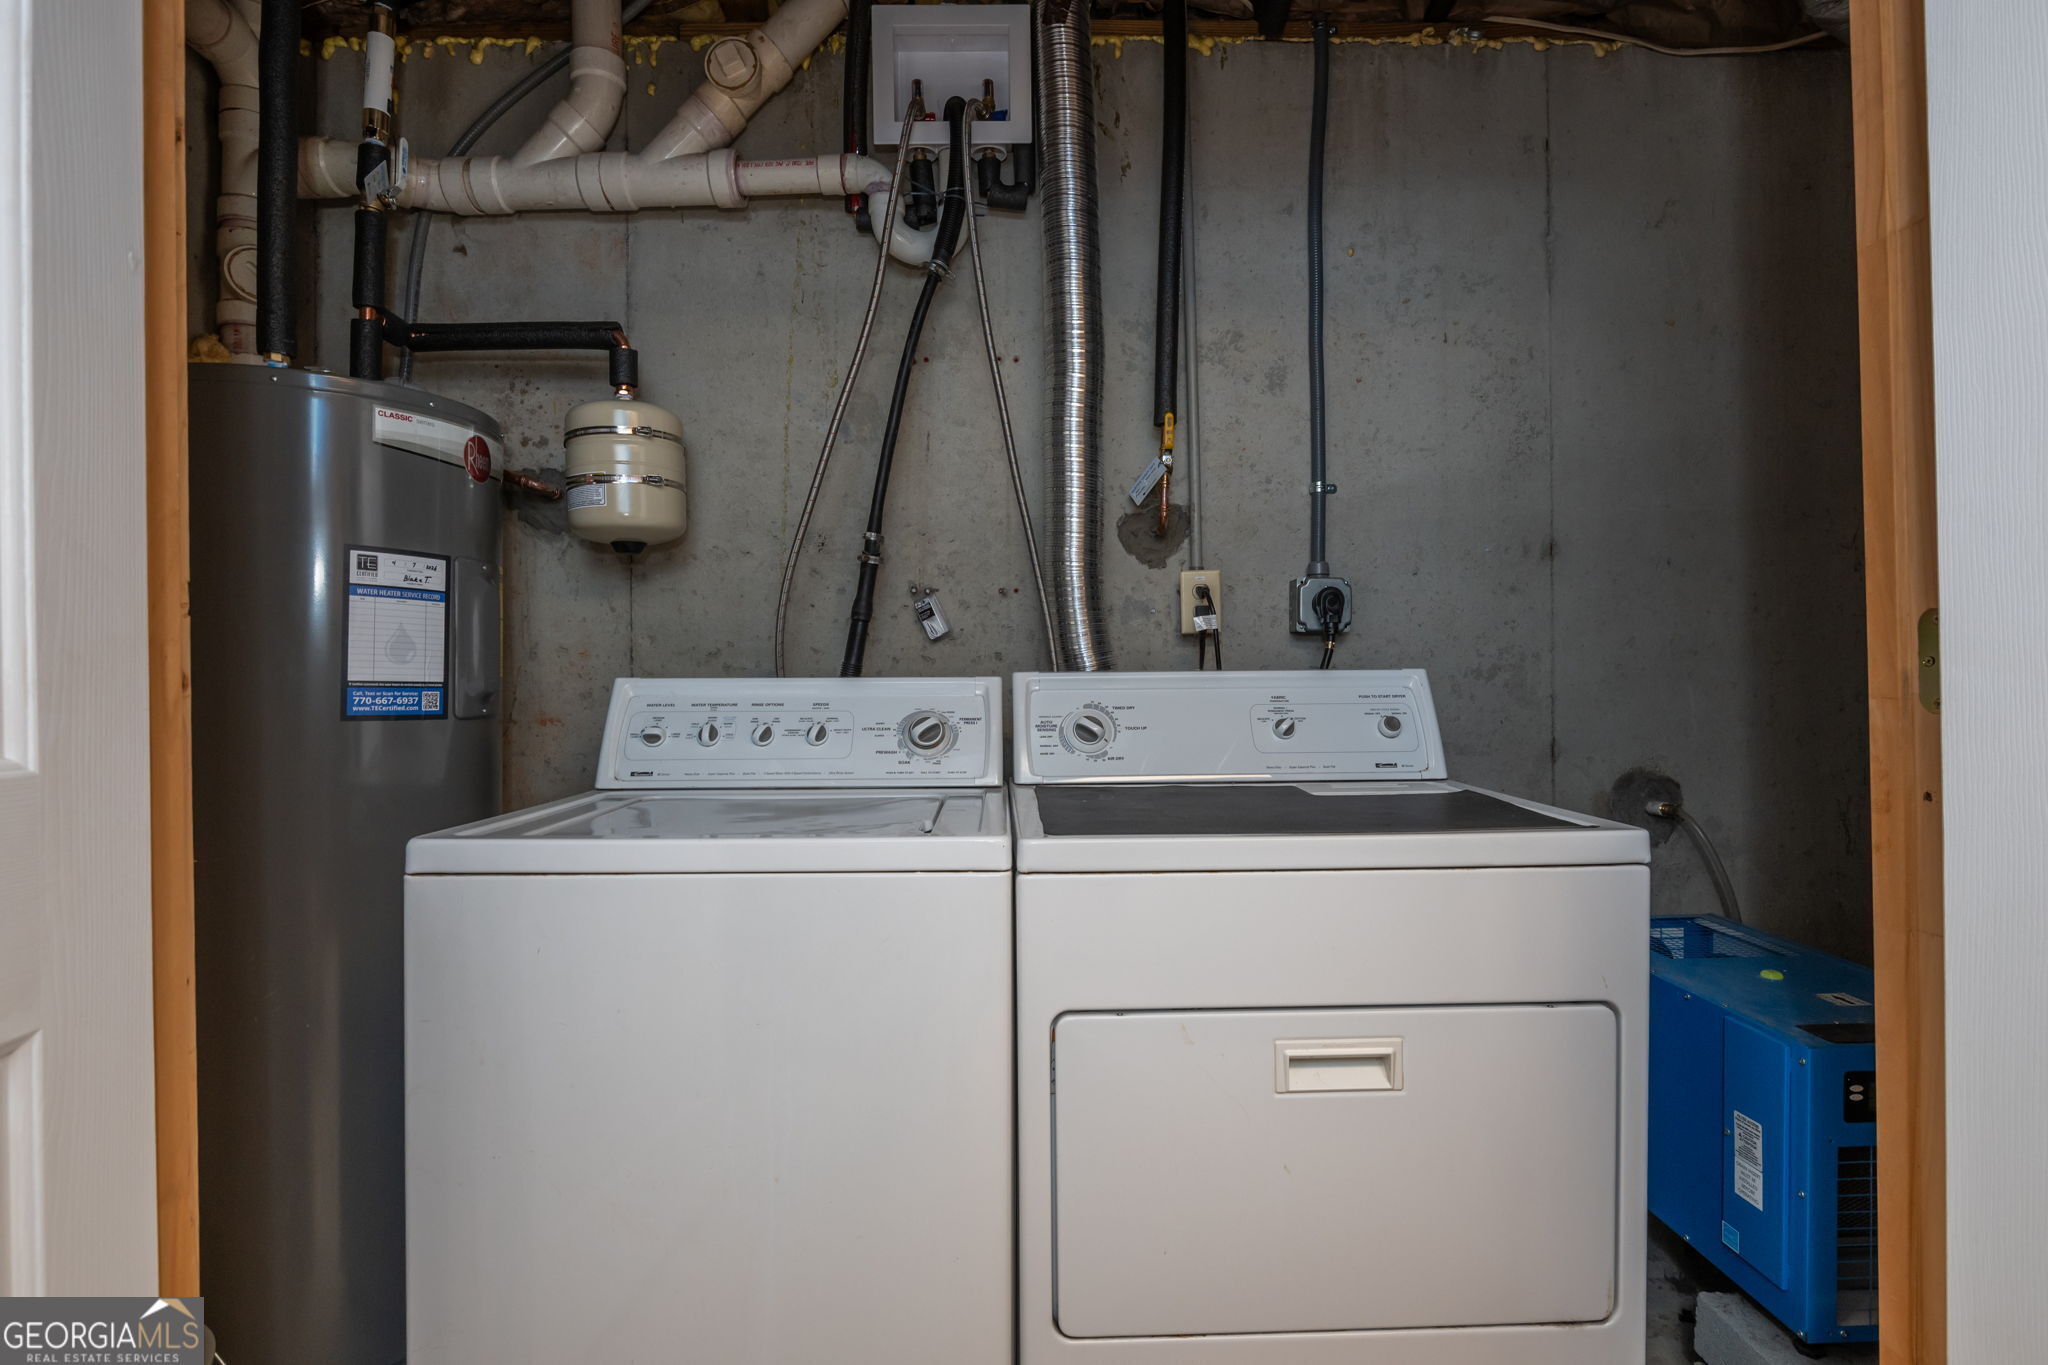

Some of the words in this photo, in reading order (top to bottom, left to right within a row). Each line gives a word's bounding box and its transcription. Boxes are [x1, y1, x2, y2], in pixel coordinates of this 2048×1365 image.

[378, 410, 413, 422] CLASSIC
[358, 556, 377, 570] TE
[403, 575, 423, 583] Blake
[402, 591, 422, 599] SERVICE
[422, 593, 441, 601] RECORD
[352, 696, 419, 705] 770-667-6937
